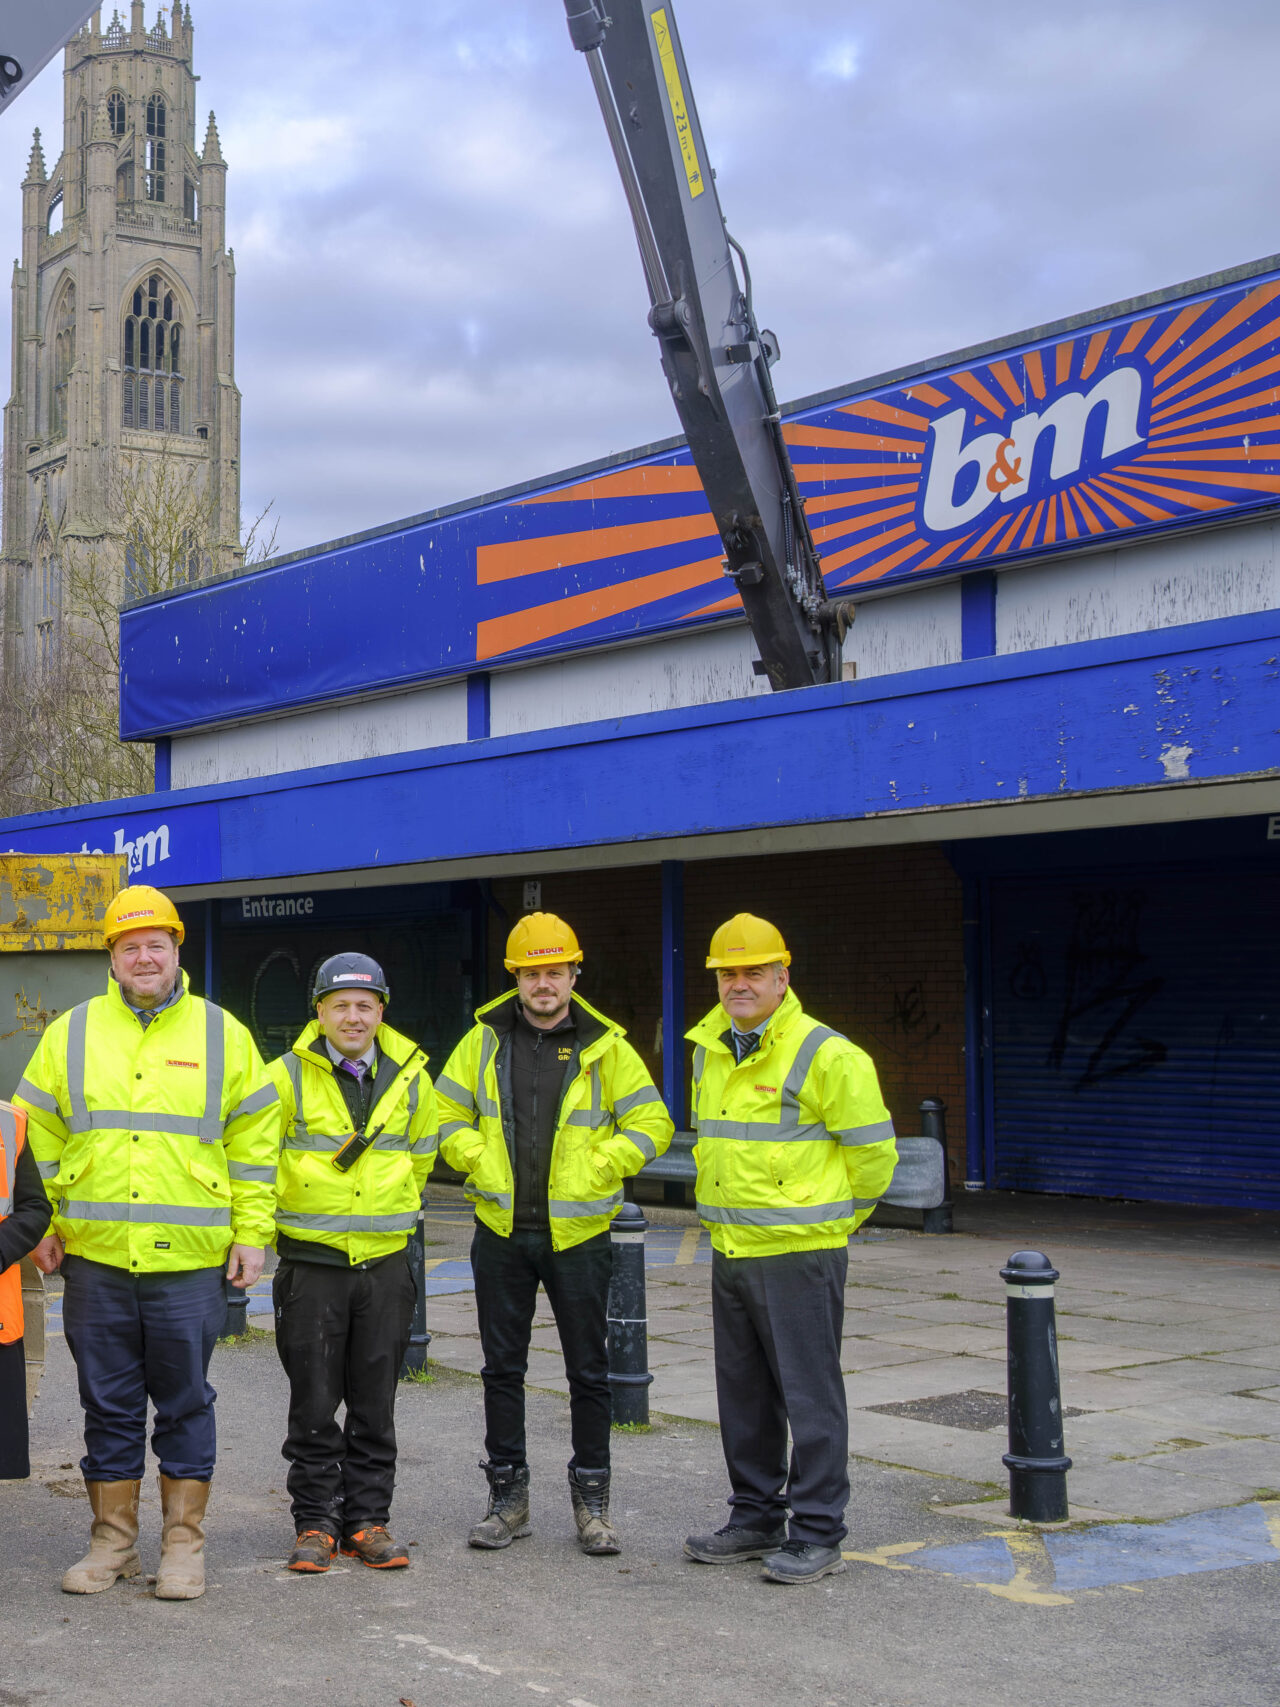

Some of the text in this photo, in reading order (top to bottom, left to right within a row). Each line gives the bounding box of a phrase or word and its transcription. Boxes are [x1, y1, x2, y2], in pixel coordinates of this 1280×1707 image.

[676, 111, 688, 133] 23
[923, 366, 1148, 532] b&m
[242, 896, 314, 918] Entrance
